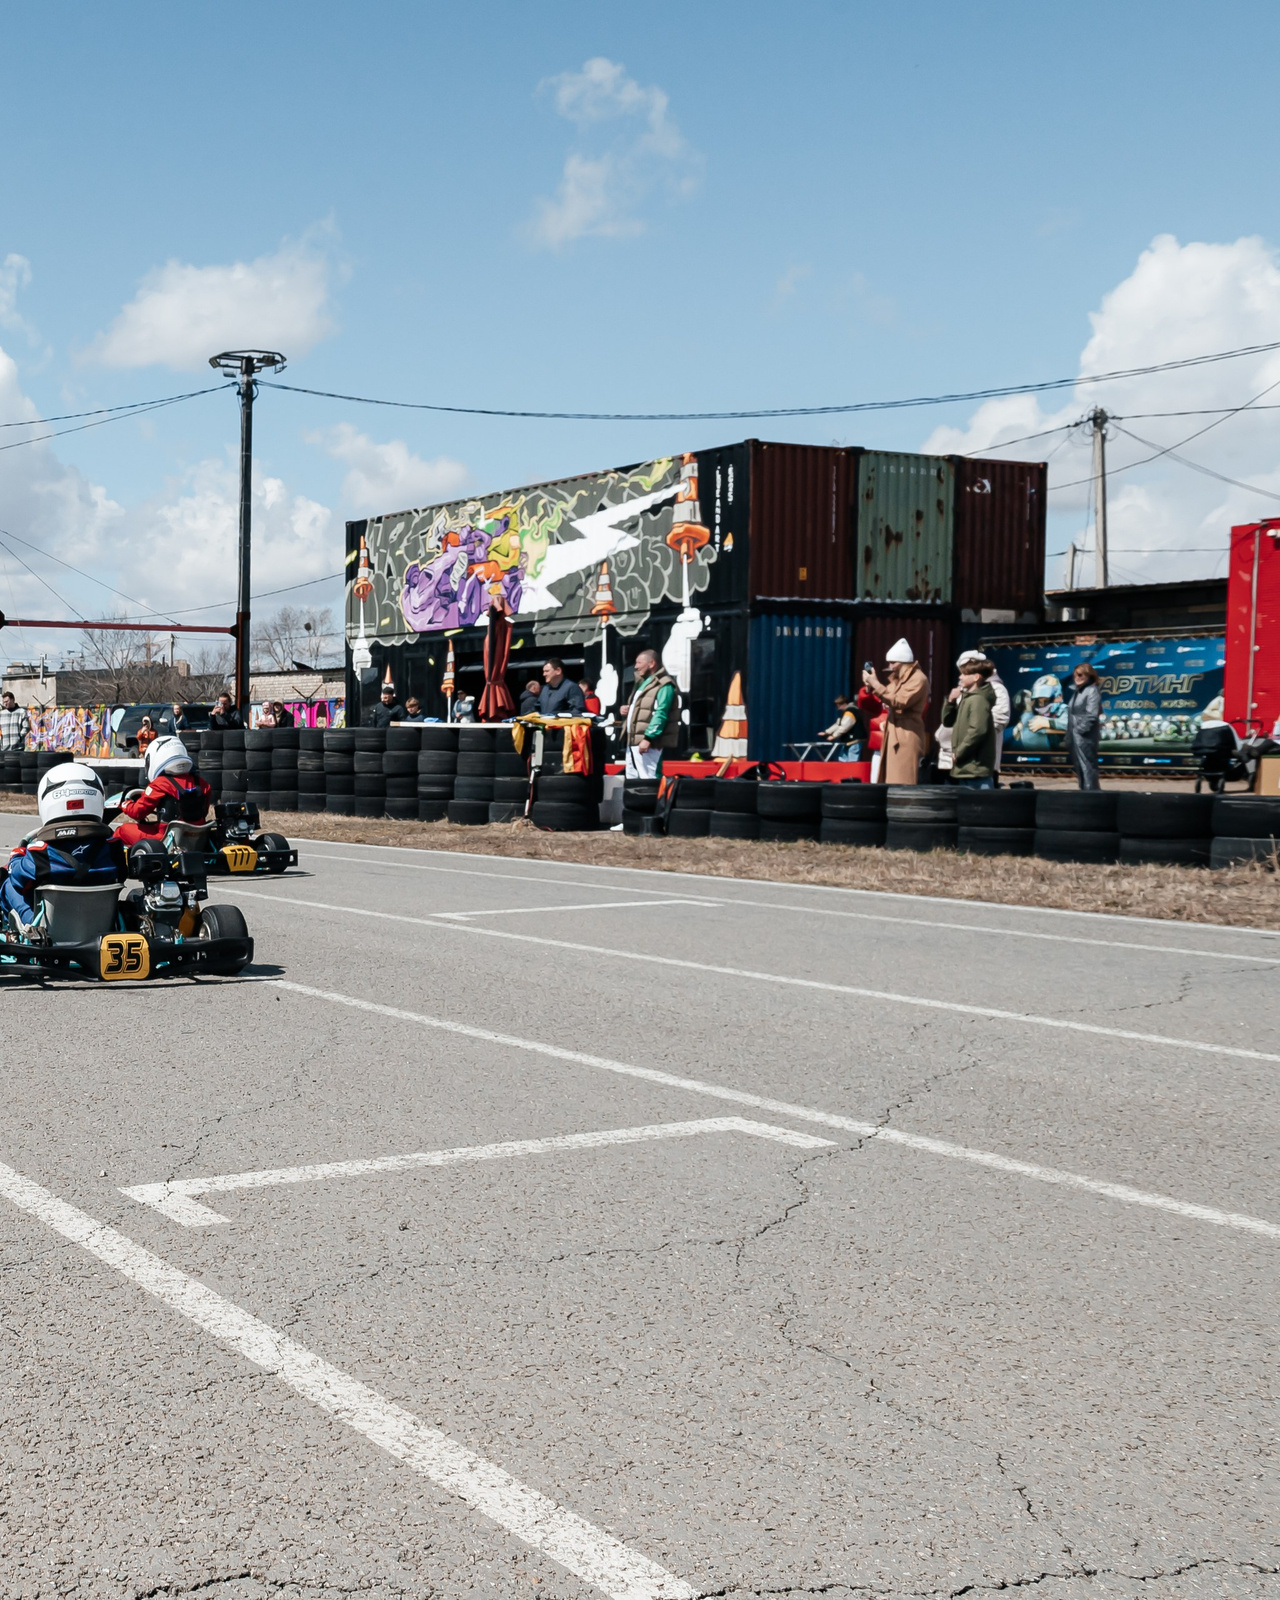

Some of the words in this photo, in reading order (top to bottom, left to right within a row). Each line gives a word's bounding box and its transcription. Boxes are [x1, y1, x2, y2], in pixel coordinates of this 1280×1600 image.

[1098, 673, 1204, 695] АРТИНГ
[230, 848, 250, 867] 777
[105, 940, 144, 974] 35
